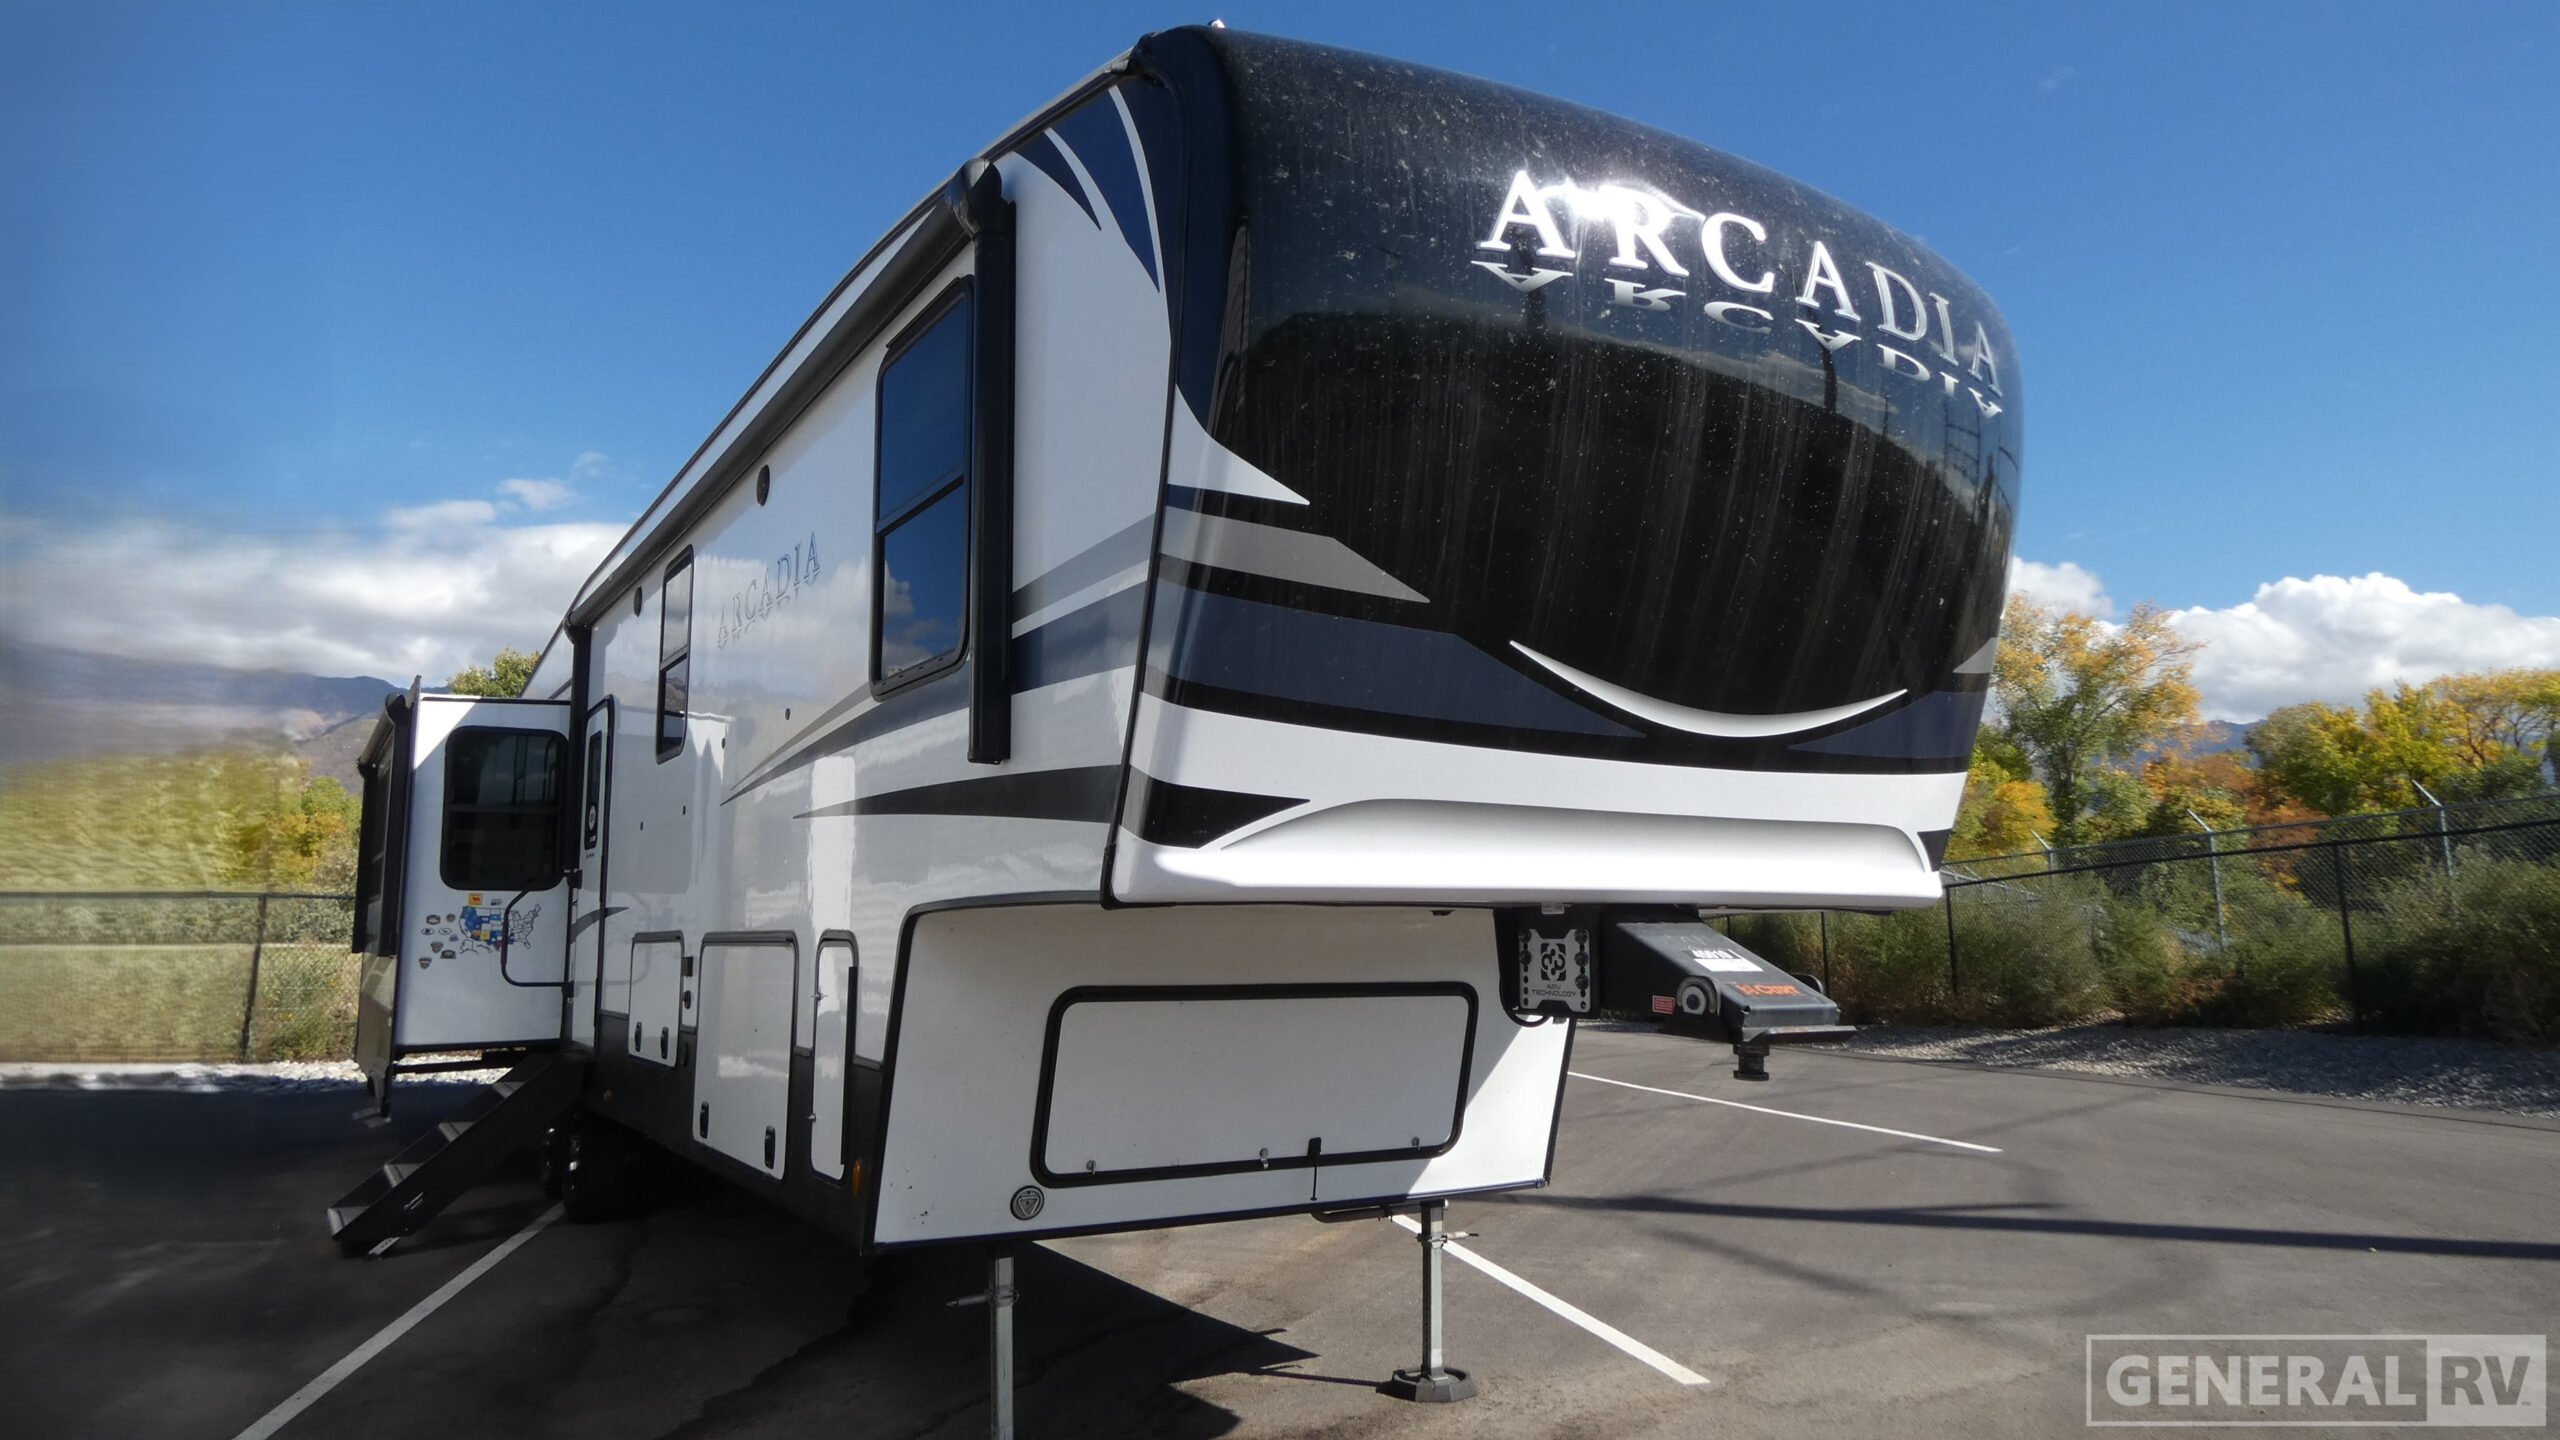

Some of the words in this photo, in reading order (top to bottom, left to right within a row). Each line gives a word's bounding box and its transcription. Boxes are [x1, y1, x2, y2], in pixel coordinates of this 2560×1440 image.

[1474, 169, 2003, 398] ARCADIA
[717, 531, 820, 643] ARCADIA
[1531, 989, 1577, 998] TECHNOLOGY
